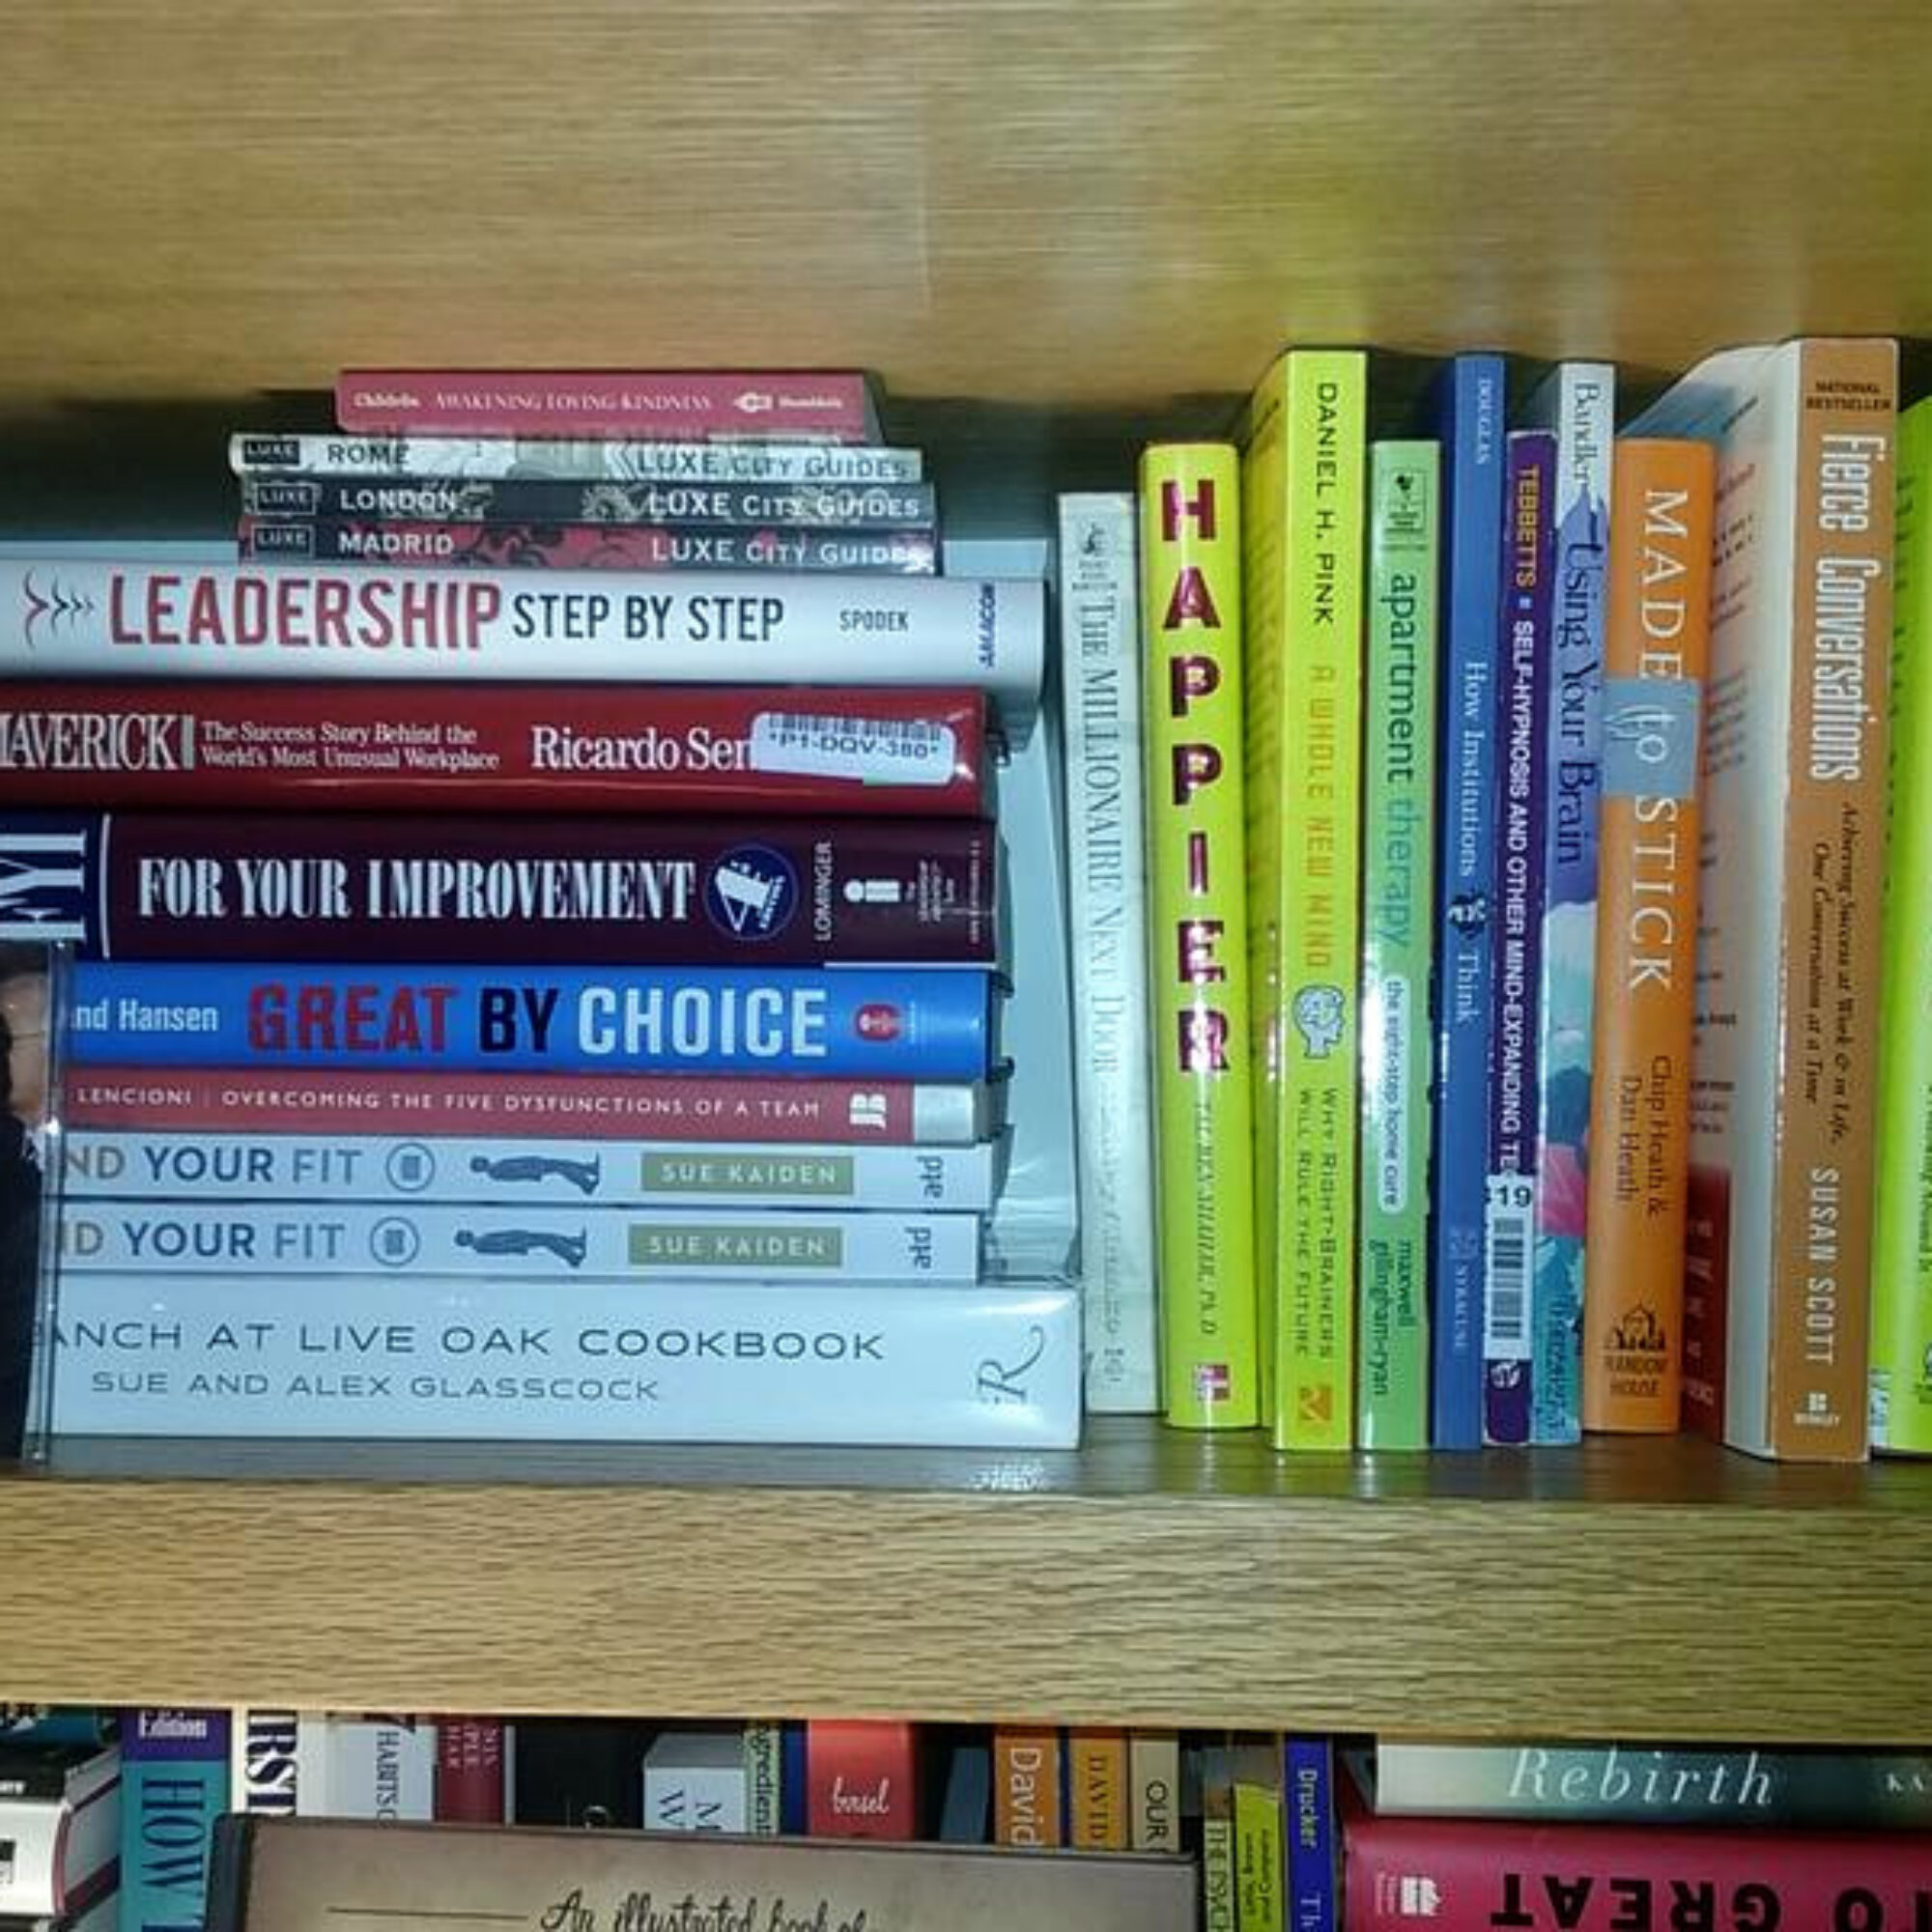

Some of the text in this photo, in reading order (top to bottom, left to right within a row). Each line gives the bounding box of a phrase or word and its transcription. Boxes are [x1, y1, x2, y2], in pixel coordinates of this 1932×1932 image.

[327, 443, 411, 467] ROME
[1574, 382, 1600, 483] Bandler
[637, 449, 728, 475] LUXE
[805, 456, 910, 480] GUIDES
[258, 486, 310, 507] LUXE
[340, 488, 459, 513] LONDON
[648, 491, 728, 518] LUXE
[816, 493, 921, 520] GUIDES
[1314, 383, 1337, 626] DANIEL H. PINK
[257, 528, 309, 550] LUXE
[338, 530, 455, 557] MADRID
[651, 536, 808, 565] LUXE CITY
[110, 574, 784, 650] LEADERSHIP STEP BY STEP
[1638, 489, 1688, 680] MADE
[1809, 435, 1886, 781] Fierce Conversations
[839, 611, 909, 633] SPODEK
[1080, 595, 1115, 657] THE
[1557, 512, 1605, 864] Using Your Brain
[202, 721, 477, 748] The Success Story Behind the
[202, 745, 500, 773] World's Most Unusual Workplace
[530, 725, 680, 770] Ricardo
[1308, 698, 1335, 800] WHOLE
[1376, 574, 1418, 947] apartment therapy
[1081, 668, 1122, 894] MILLIONAIRE
[1161, 479, 1230, 1071] HAPPIER
[1500, 464, 1540, 1134] TEBBETTS SELF-HYPNOSIS AND OTHER MIND-EXPANDING
[1307, 817, 1334, 877] NEW
[1457, 663, 1488, 1025] How Institutions Think
[139, 858, 225, 919] FOR
[235, 858, 351, 919] YOUR
[367, 858, 696, 921] IMPROVEMENT
[813, 840, 832, 943] LOMINGER
[1629, 795, 1678, 990] STICK
[1088, 905, 1123, 978] NEXT
[1306, 894, 1334, 967] MIND
[71, 999, 219, 1033] nd Hansen
[247, 982, 458, 1054] GREAT
[480, 987, 559, 1054] BY
[580, 987, 826, 1058] CHOICE
[1387, 980, 1404, 1009] the
[77, 1089, 191, 1106] LENCIONI
[221, 1090, 820, 1118] OVERCOMING THE FIVE DYSFUNCTIONS OF A TEAM
[1619, 1075, 1642, 1121] Dan
[1644, 1054, 1671, 1112] Chip
[1384, 1109, 1402, 1160] home
[1645, 1119, 1670, 1195] Heath
[143, 1146, 363, 1183] YOUR FIT
[661, 1163, 837, 1185] SUE KAIDEN
[1383, 1165, 1400, 1206] cure
[1496, 1184, 1533, 1208] 19
[123, 1221, 254, 1258] YOUR
[273, 1224, 346, 1260] FIT
[648, 1235, 826, 1257] SUE KAIDEN
[1805, 1167, 1839, 1367] SUSAN SCOTT
[1397, 1239, 1417, 1326] maxwell
[206, 1323, 885, 1360] AT LIVE OAK COOKBOOK
[92, 1372, 659, 1402] SUE AND ALEX GLASSCOCK
[1010, 1747, 1043, 1846] David
[1089, 1755, 1109, 1841] DAVID
[1507, 1747, 1774, 1806] Rebirth
[141, 1778, 205, 1899] HOW
[1145, 1779, 1170, 1847] OUR
[540, 1889, 594, 1932] An
[614, 1891, 758, 1932] illustrated
[770, 1897, 829, 1932] book
[1491, 1872, 1781, 1932] GREAT
